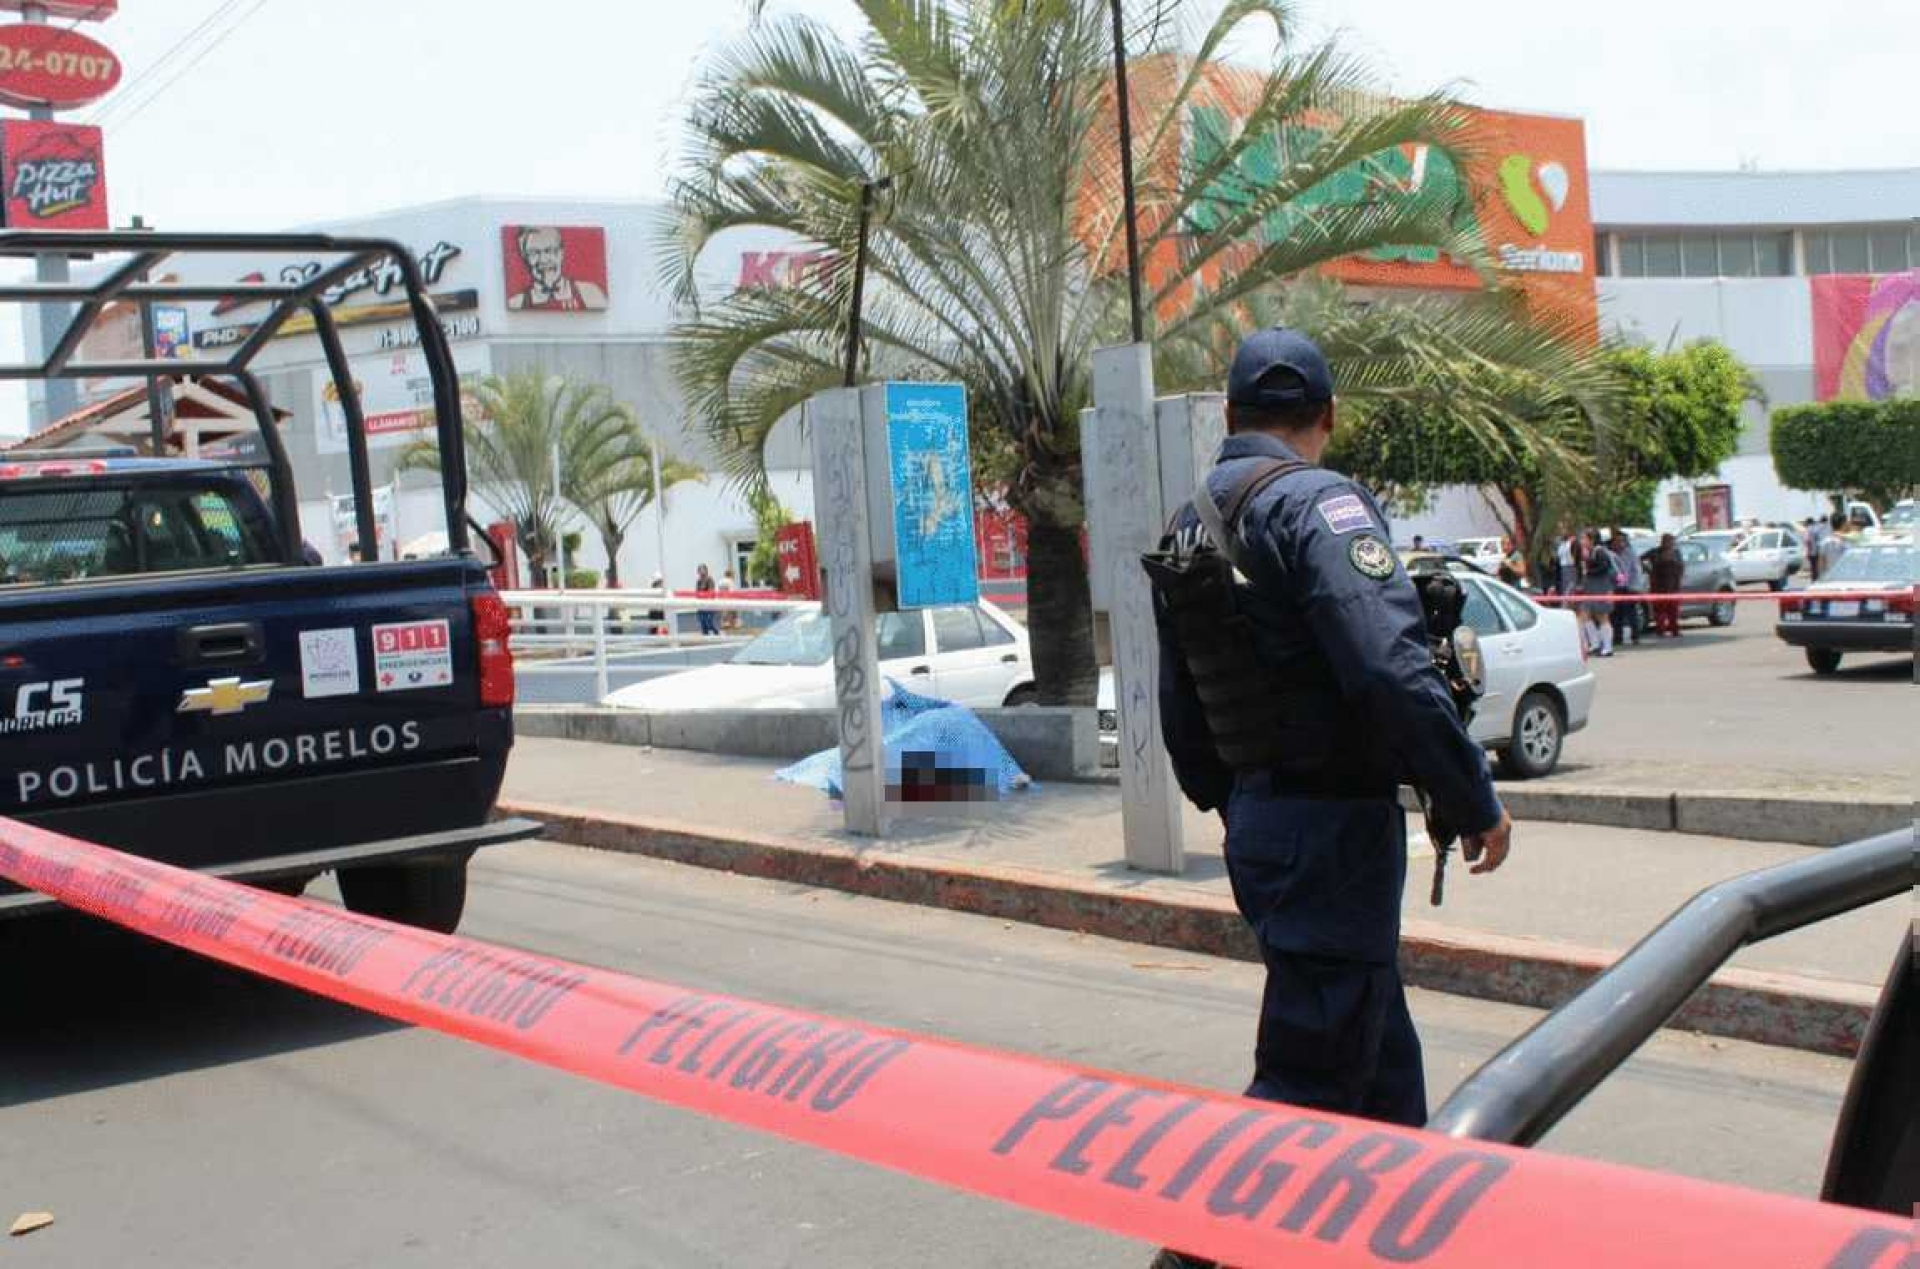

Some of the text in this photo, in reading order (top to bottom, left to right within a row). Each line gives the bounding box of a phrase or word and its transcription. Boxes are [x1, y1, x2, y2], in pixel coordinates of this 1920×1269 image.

[13, 161, 95, 194] Pizza
[29, 183, 83, 210] Hut
[380, 627, 442, 651] 911
[17, 719, 421, 803] POLICÍA MORELOS
[401, 948, 592, 1030] PELIGRO
[616, 996, 911, 1113] PELIGRO
[990, 1073, 1512, 1264] PELIGRO
